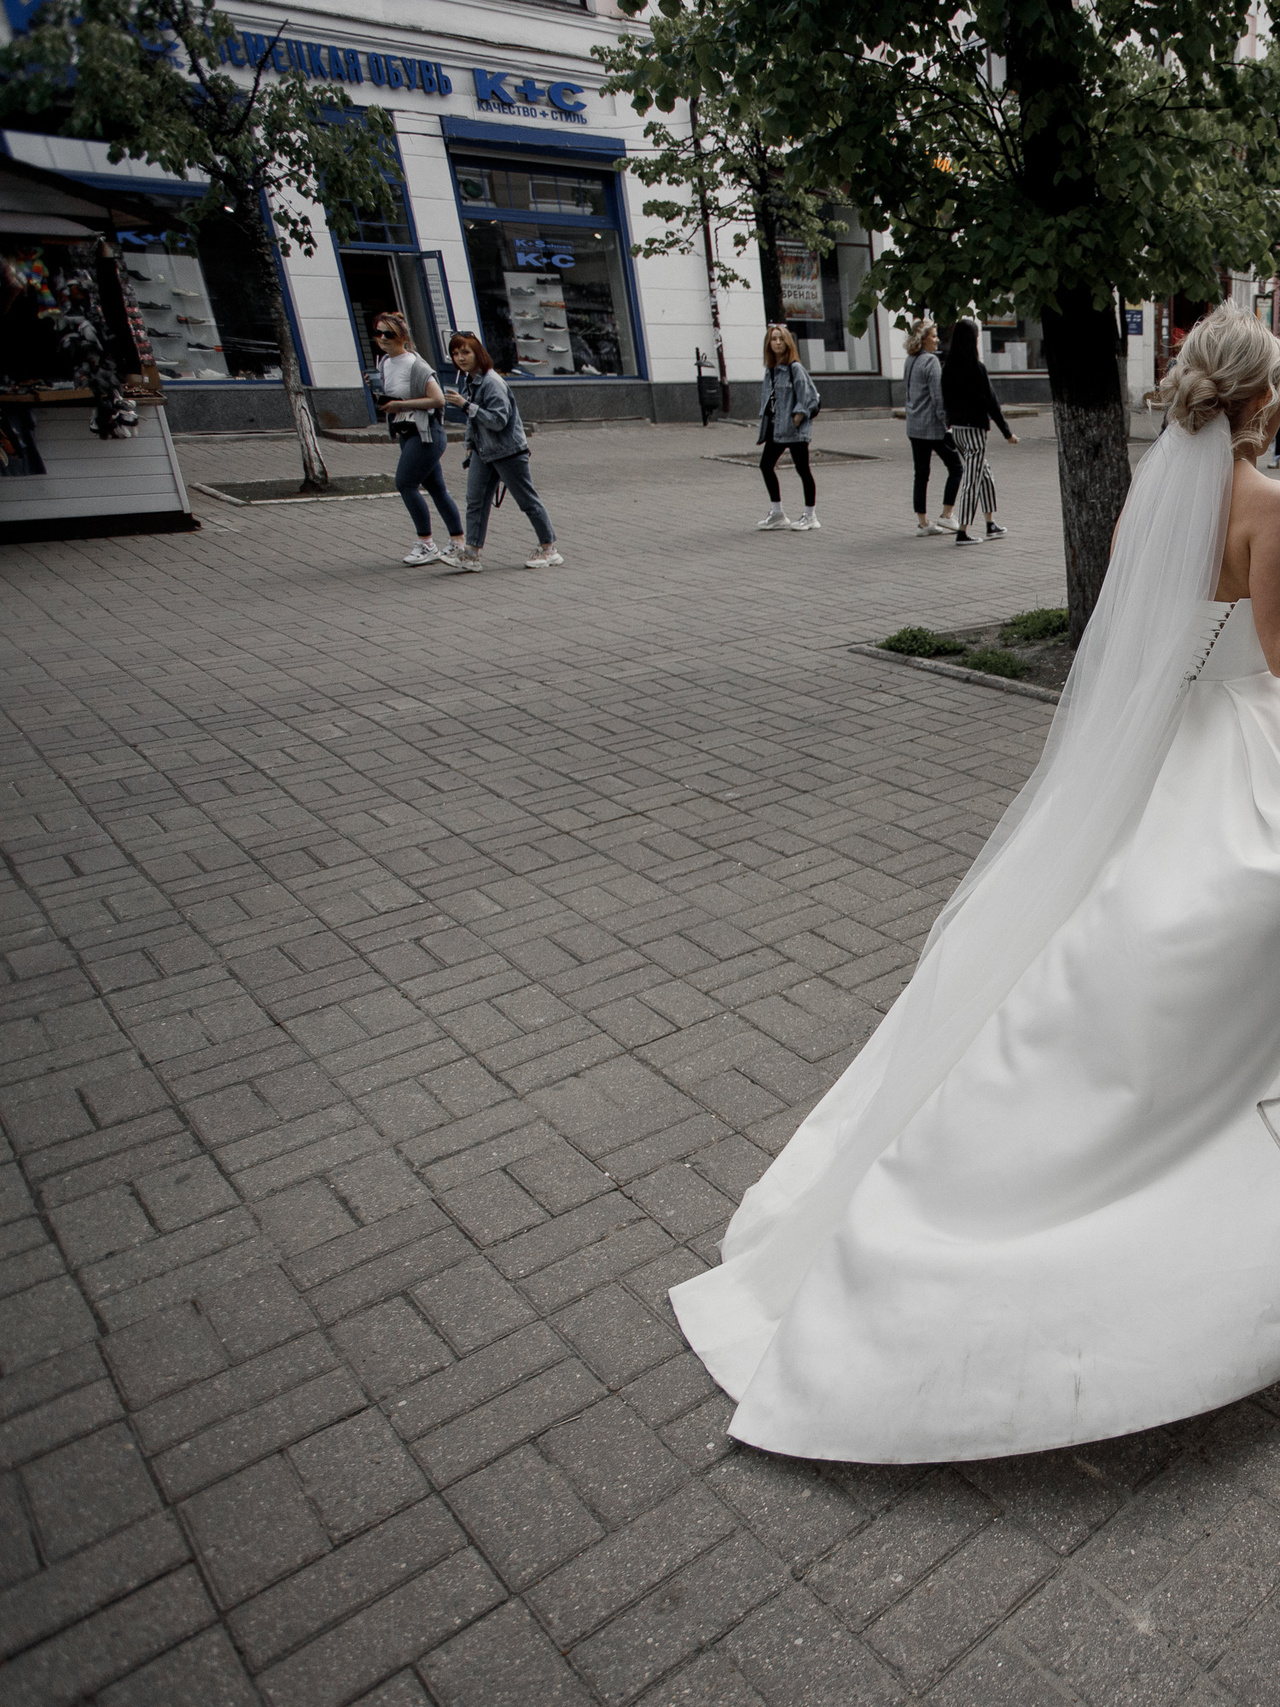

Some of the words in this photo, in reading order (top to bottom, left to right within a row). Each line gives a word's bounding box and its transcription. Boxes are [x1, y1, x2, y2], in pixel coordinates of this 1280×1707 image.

[367, 51, 453, 96] ОБУВЬ
[477, 100, 537, 118] КАЧЕСТВО
[551, 110, 588, 125] СТИЛЬ
[781, 290, 818, 300] БРЕНДЫ
